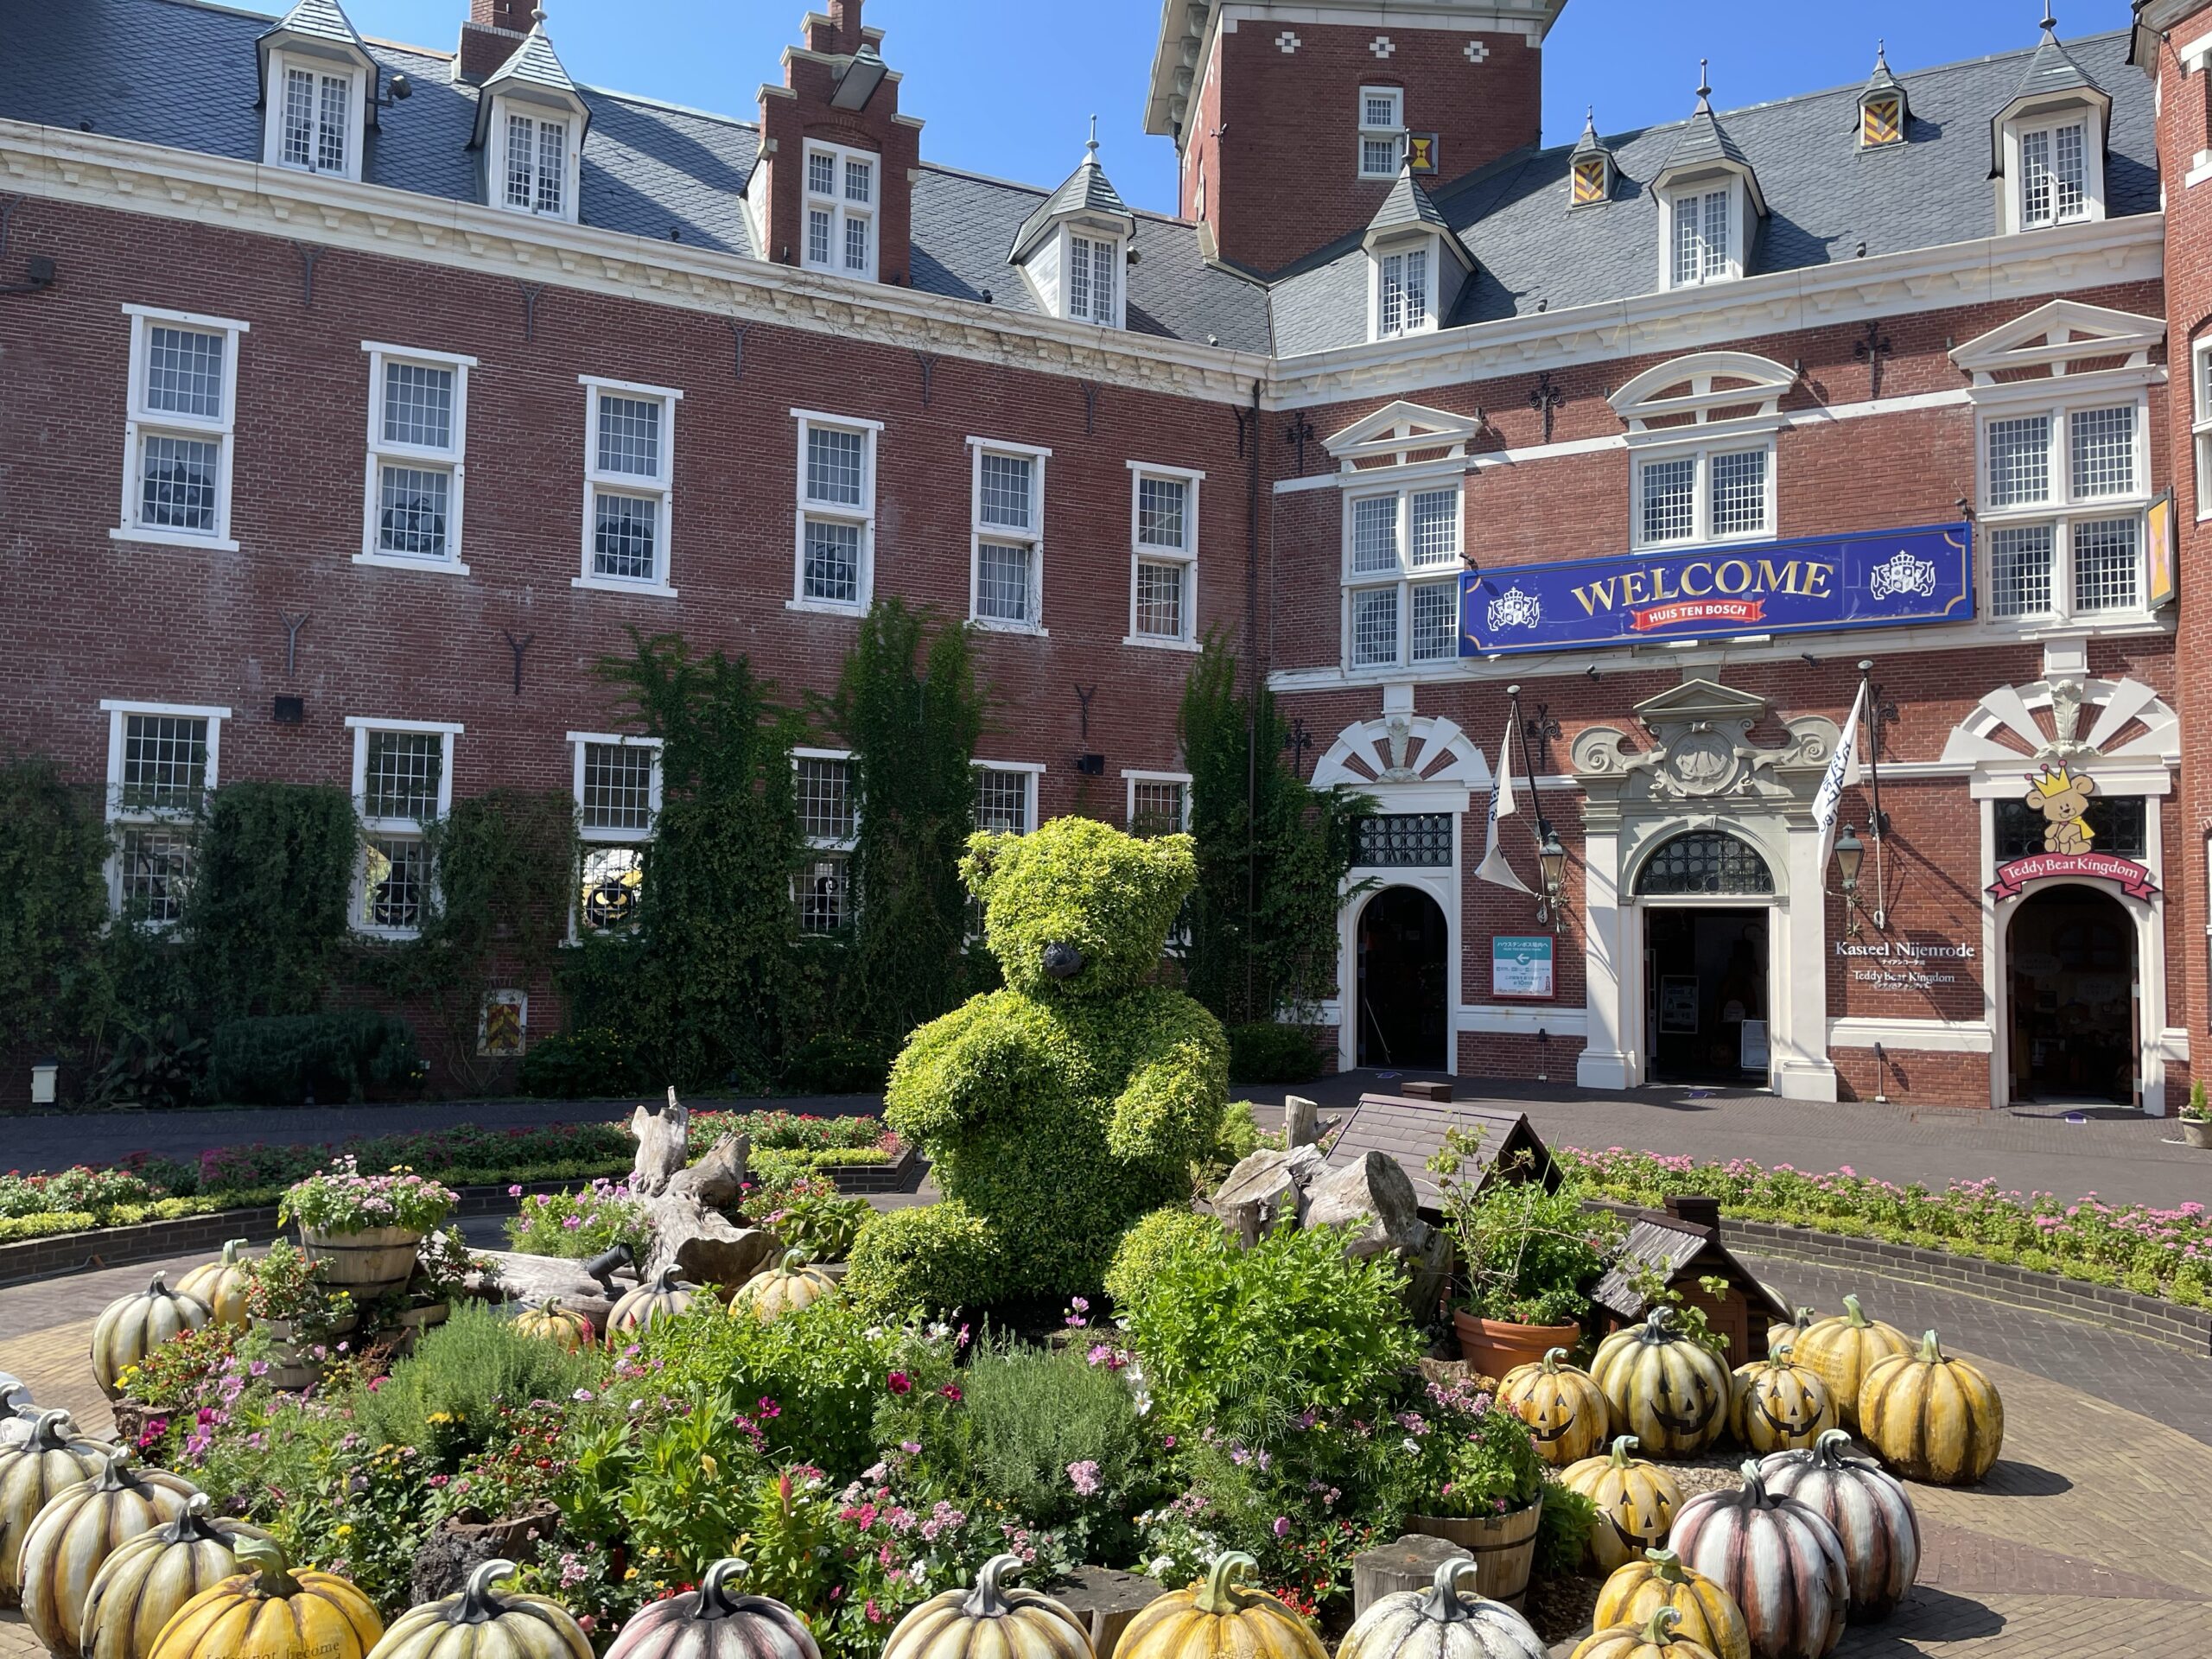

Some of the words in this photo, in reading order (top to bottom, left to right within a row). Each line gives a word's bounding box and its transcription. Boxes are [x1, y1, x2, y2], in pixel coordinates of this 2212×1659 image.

[1571, 560, 1834, 616] WELCOME
[1649, 607, 1678, 623] HUIS
[1680, 605, 1703, 618] TEN
[1706, 604, 1747, 617] BOSCH
[2005, 861, 2044, 879] Teddy
[2046, 860, 2075, 871] Bear
[2077, 858, 2139, 879] Kingdom
[1835, 942, 1889, 957] Kasteel
[1896, 942, 1975, 958] Nijenrode
[1852, 970, 1882, 982] Teddy
[1885, 971, 1906, 981] Bear
[1908, 971, 1955, 983] Kingdom
[287, 1642, 340, 1659] become
